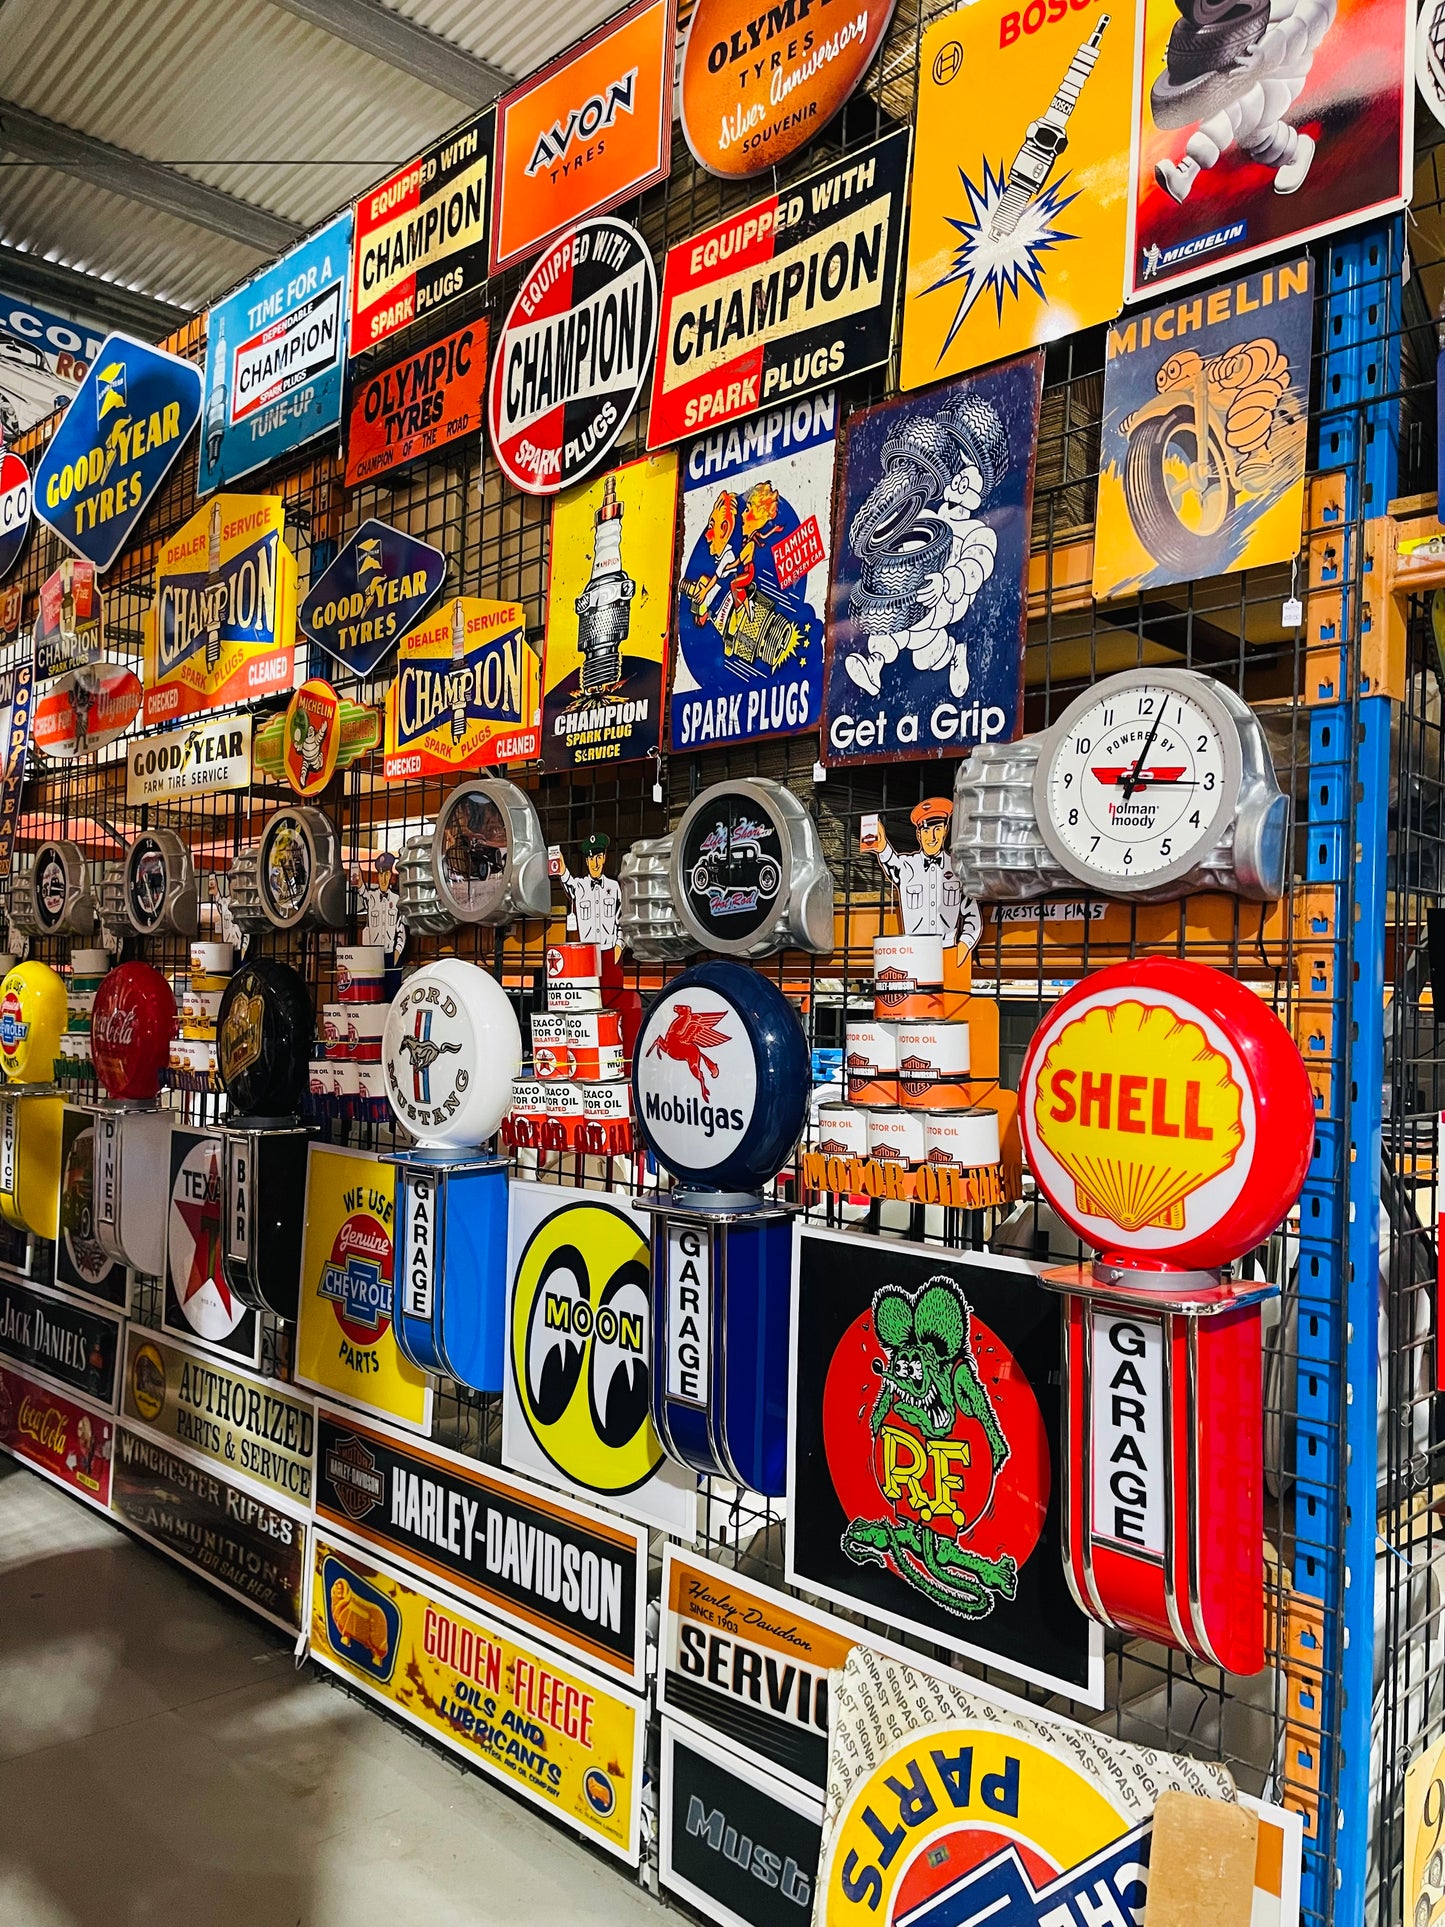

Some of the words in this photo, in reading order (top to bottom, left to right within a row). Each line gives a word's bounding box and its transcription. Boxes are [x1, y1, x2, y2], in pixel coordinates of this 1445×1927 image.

[708, 0, 834, 73] OLYM
[1000, 0, 1101, 49] BOS
[718, 103, 766, 150] Silver
[770, 10, 868, 106] Anniversary
[739, 30, 814, 88] TYRES
[526, 68, 637, 175] AVON
[742, 102, 817, 153] SOUVENIR
[1050, 97, 1073, 115] BOSCH
[371, 161, 436, 221] EQUIPPED
[441, 129, 478, 172] WITH
[550, 140, 605, 184] TYRES
[363, 178, 482, 291] CHAMPION
[690, 197, 804, 276] EQUIPPED
[811, 158, 876, 214] WITH
[1162, 224, 1244, 264] MICHELIN
[248, 291, 283, 331] TIME
[287, 270, 317, 307] FOR
[320, 256, 332, 284] A
[520, 233, 590, 317] EQUIPPED
[592, 230, 632, 271] WITH
[673, 222, 882, 366] CHAMPION
[262, 303, 314, 343] DEPENDABLE
[371, 294, 414, 338] SPARK
[417, 266, 464, 312] PLUGS
[1107, 261, 1309, 359] MICHELIN
[240, 313, 334, 392] CHAMPION
[364, 331, 473, 423] OLYMPIC
[506, 282, 638, 424] CHAMPION
[260, 382, 283, 404] SPARK
[283, 369, 307, 396] PLUGS
[684, 375, 758, 427] SPARK
[763, 340, 845, 397] PLUGS
[250, 386, 315, 442] TUNE-UP
[385, 390, 443, 446] TYRES
[515, 439, 562, 475] SPARK
[565, 401, 617, 468] PLUGS
[689, 390, 836, 480] CHAMPION
[357, 451, 393, 477] CHAMPION
[402, 439, 413, 457] OF
[422, 429, 436, 446] THE
[447, 415, 468, 438] ROAD
[75, 471, 142, 536] TYRES
[167, 535, 206, 563] DEALER
[223, 507, 271, 541] SERVICE
[774, 520, 815, 564] FLAMING
[777, 538, 818, 577] YOUTH
[780, 575, 793, 589] FOR
[792, 561, 810, 578] EVERY
[811, 551, 823, 564] CAR
[160, 534, 279, 667] CHAMPION
[408, 626, 449, 650] DEALER
[467, 607, 516, 634] SERVICE
[38, 628, 98, 668] CHAMPION
[338, 612, 396, 650] TYRES
[181, 665, 207, 689] SPARK
[214, 649, 244, 688] PLUGS
[248, 656, 288, 686] CLEANED
[400, 631, 523, 737] CHAMPION
[148, 689, 178, 715] CHECKED
[299, 696, 334, 719] MICHELIN
[554, 699, 648, 737] CHAMPION
[681, 693, 743, 744] SPARK
[747, 680, 810, 733] PLUGS
[830, 711, 887, 749] Get
[896, 716, 918, 744] a
[931, 701, 1006, 745] Grip
[1104, 709, 1113, 726] 11
[1139, 699, 1154, 716] 12
[424, 736, 452, 758] SPARK
[461, 725, 491, 757] PLUGS
[496, 735, 535, 759] CLEANED
[566, 728, 601, 747] SPARK
[603, 724, 632, 743] PLUG
[574, 744, 620, 763] SERVICE
[1076, 738, 1090, 754] 10
[1106, 731, 1159, 755] POWERED
[1161, 738, 1175, 752] BY
[1197, 735, 1208, 752] 2
[144, 775, 164, 793] FARM
[168, 771, 186, 788] TIRE
[191, 766, 228, 785] SERVICE
[387, 756, 421, 776] CHECKED
[1064, 773, 1073, 789] 9
[1203, 772, 1215, 790] 3
[1069, 809, 1078, 825] 8
[1108, 802, 1156, 818] holman
[1111, 815, 1155, 828] moody
[1189, 811, 1200, 828] 4
[1090, 837, 1100, 852] 7
[1123, 848, 1132, 864] 6
[1160, 839, 1171, 856] 5
[399, 986, 458, 1018] FORD
[387, 1059, 469, 1126] MUSTANG
[646, 1092, 744, 1137] Mobilgas
[1050, 1069, 1213, 1141] SHELL
[105, 1123, 114, 1219] DINER
[804, 1152, 905, 1200] MOTOR
[916, 1165, 967, 1208] OIL
[236, 1158, 245, 1241] BAR
[343, 1187, 363, 1213] WE
[369, 1189, 393, 1224] USE
[340, 1224, 389, 1255] Genuine
[412, 1179, 429, 1312] GARAGE
[545, 1292, 643, 1354] MOON
[678, 1231, 700, 1398] GARAGE
[338, 1340, 379, 1373] PARTS
[178, 1362, 314, 1458] AUTHORIZED
[1109, 1322, 1148, 1546] GARAGE
[177, 1408, 220, 1453] PARTS
[224, 1431, 235, 1461] &
[240, 1438, 311, 1499] SERVICE
[329, 1458, 380, 1495] HARLEY-DAVIDSON
[121, 1432, 219, 1506] WINCHESTER
[226, 1488, 292, 1545] RIFLES
[148, 1508, 277, 1585] AMMUNITION
[391, 1466, 622, 1634] HARLEY-DAVIDSON
[198, 1547, 219, 1570] FOR
[219, 1562, 246, 1586] SALE
[247, 1576, 278, 1605] HERE
[689, 1602, 714, 1624] SINCE
[717, 1616, 739, 1634] 1903
[423, 1608, 502, 1695] GOLDEN
[514, 1657, 595, 1750] FLEECE
[856, 1644, 890, 1708] SIGNPAST
[440, 1696, 562, 1786] LUBRICANTS
[455, 1681, 496, 1718] OILS
[501, 1709, 545, 1746] AND
[858, 1682, 887, 1751] SIGNPAST
[529, 1774, 560, 1798] COMPANY
[685, 1795, 810, 1908] Must
[843, 1746, 1020, 1911] PARTS
